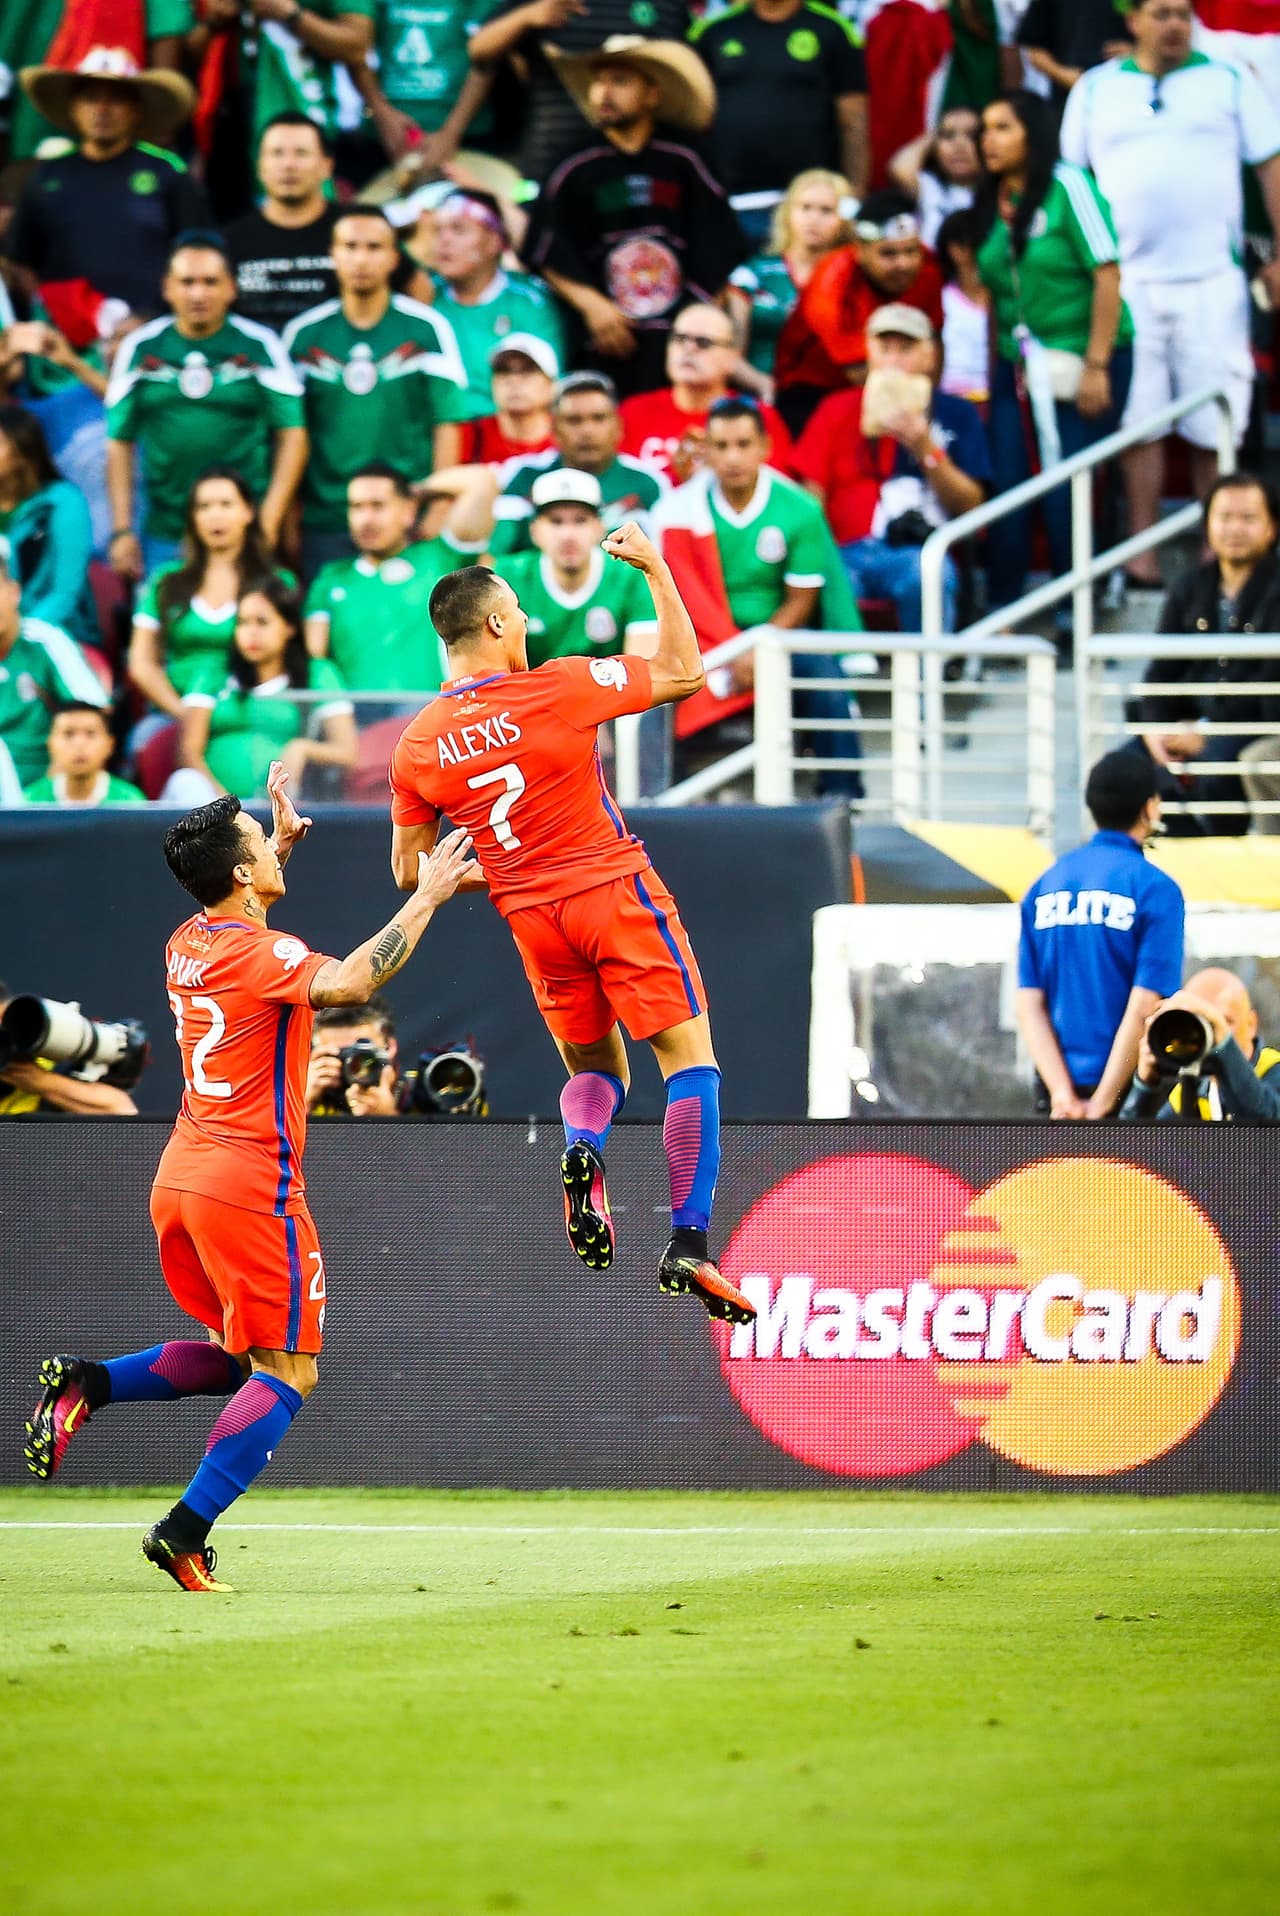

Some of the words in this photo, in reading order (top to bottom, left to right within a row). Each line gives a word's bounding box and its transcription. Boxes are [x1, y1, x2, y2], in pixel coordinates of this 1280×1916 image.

[436, 711, 522, 769] ALEXIS
[466, 763, 526, 851] 7
[1034, 889, 1137, 931] ELITE
[729, 1271, 1223, 1363] MasterCard
